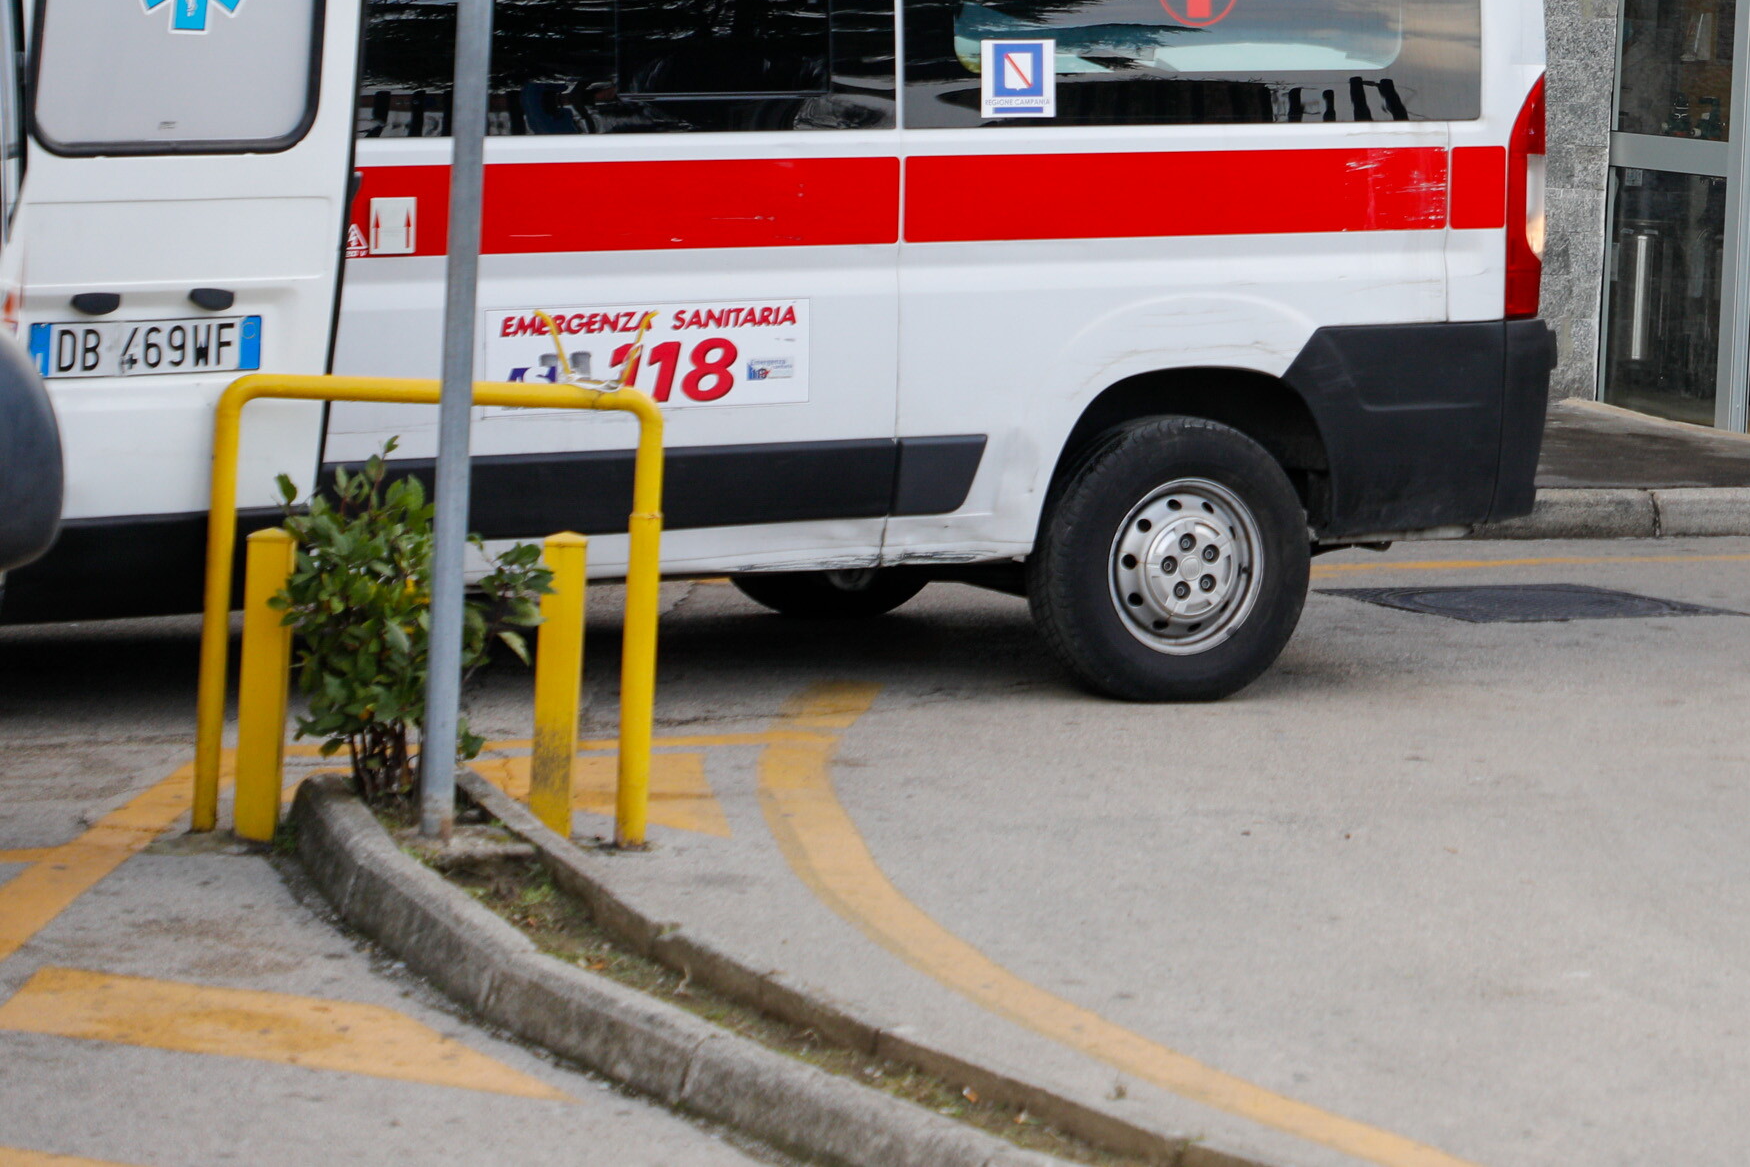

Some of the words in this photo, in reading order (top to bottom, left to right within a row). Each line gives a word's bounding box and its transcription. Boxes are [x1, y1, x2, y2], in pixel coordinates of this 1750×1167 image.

[1014, 98, 1050, 106] CAMPANIA
[500, 311, 653, 337] EMERGENZA
[671, 305, 797, 331] SANITARIA
[58, 328, 100, 372] DB
[119, 322, 235, 370] 469WF
[609, 337, 738, 402] 118
